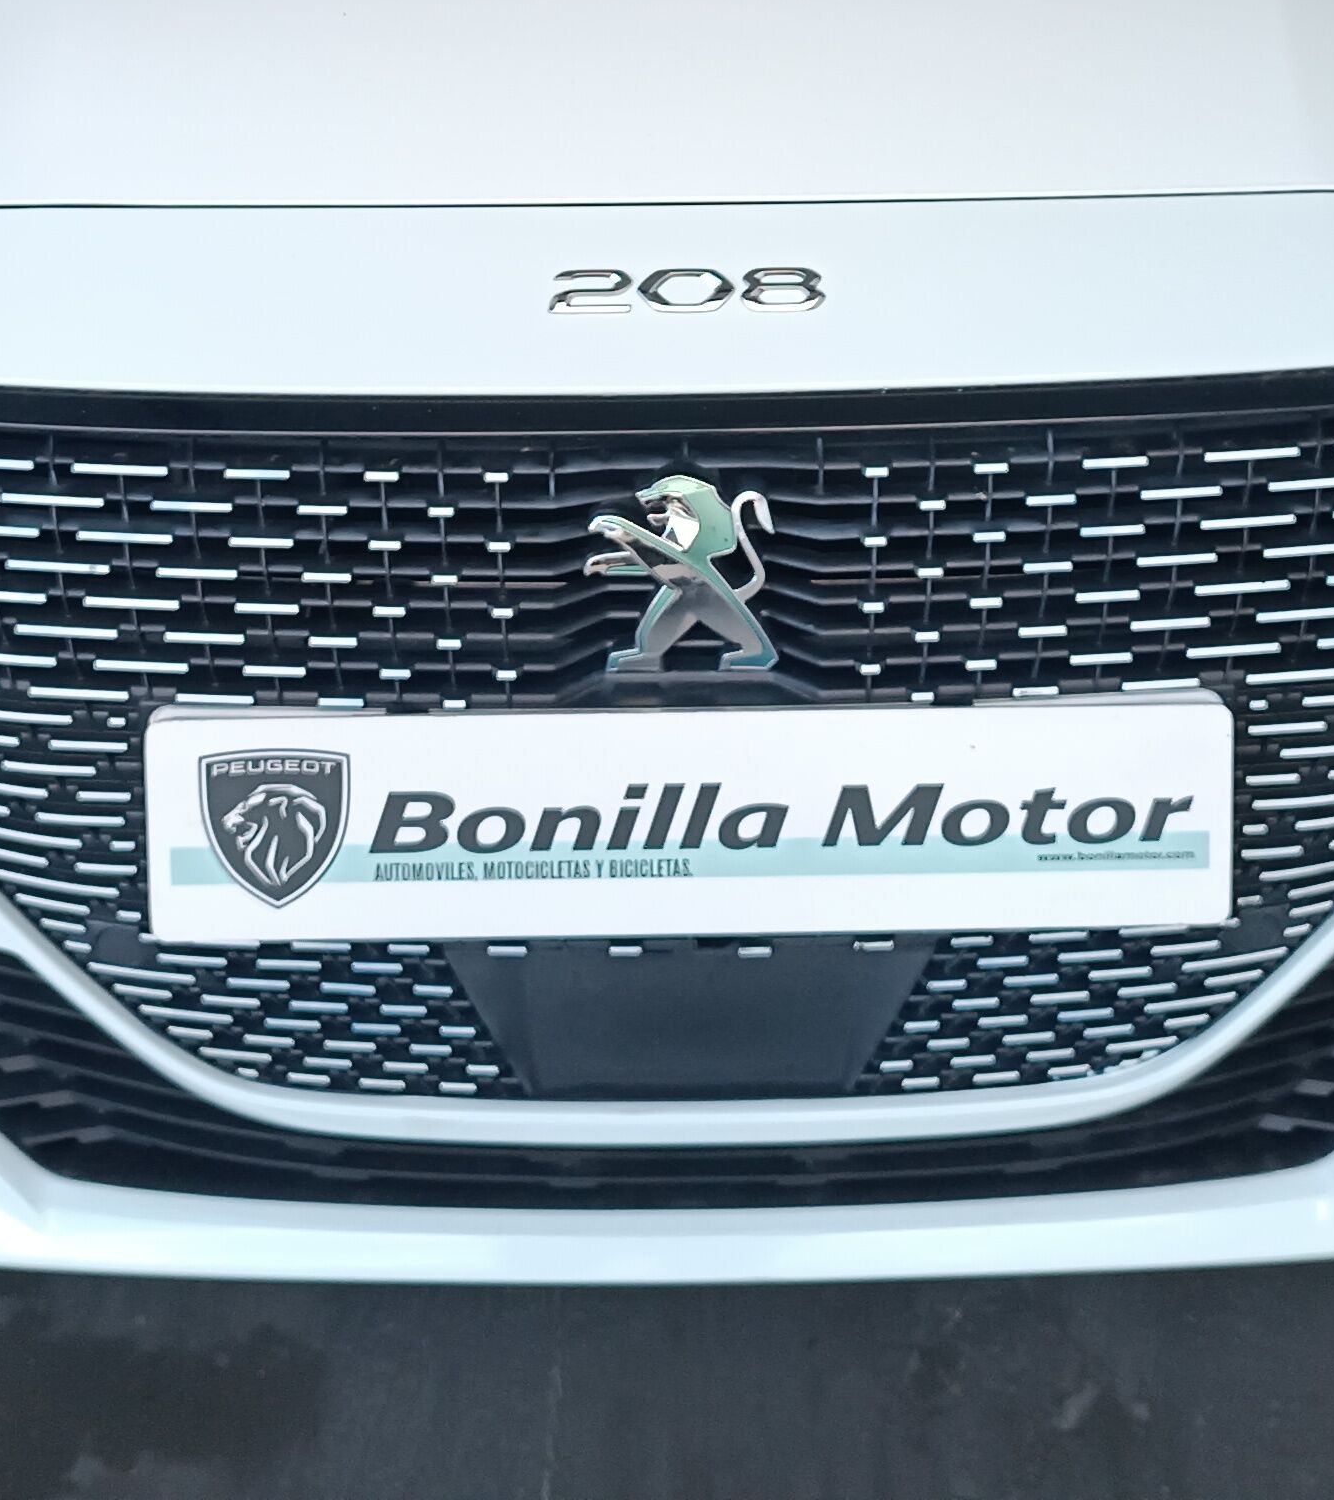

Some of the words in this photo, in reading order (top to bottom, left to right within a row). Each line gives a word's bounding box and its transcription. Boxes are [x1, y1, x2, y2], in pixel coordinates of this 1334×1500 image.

[548, 267, 826, 314] 208
[210, 758, 337, 778] PEUGEOT
[369, 782, 789, 854] Bonilla
[822, 783, 1194, 847] Motor
[375, 860, 478, 883] AUTOMOVILES,
[483, 859, 590, 881] MOTOCICLETAS
[594, 859, 605, 879] Y
[610, 857, 693, 878] BICICLETAS.
